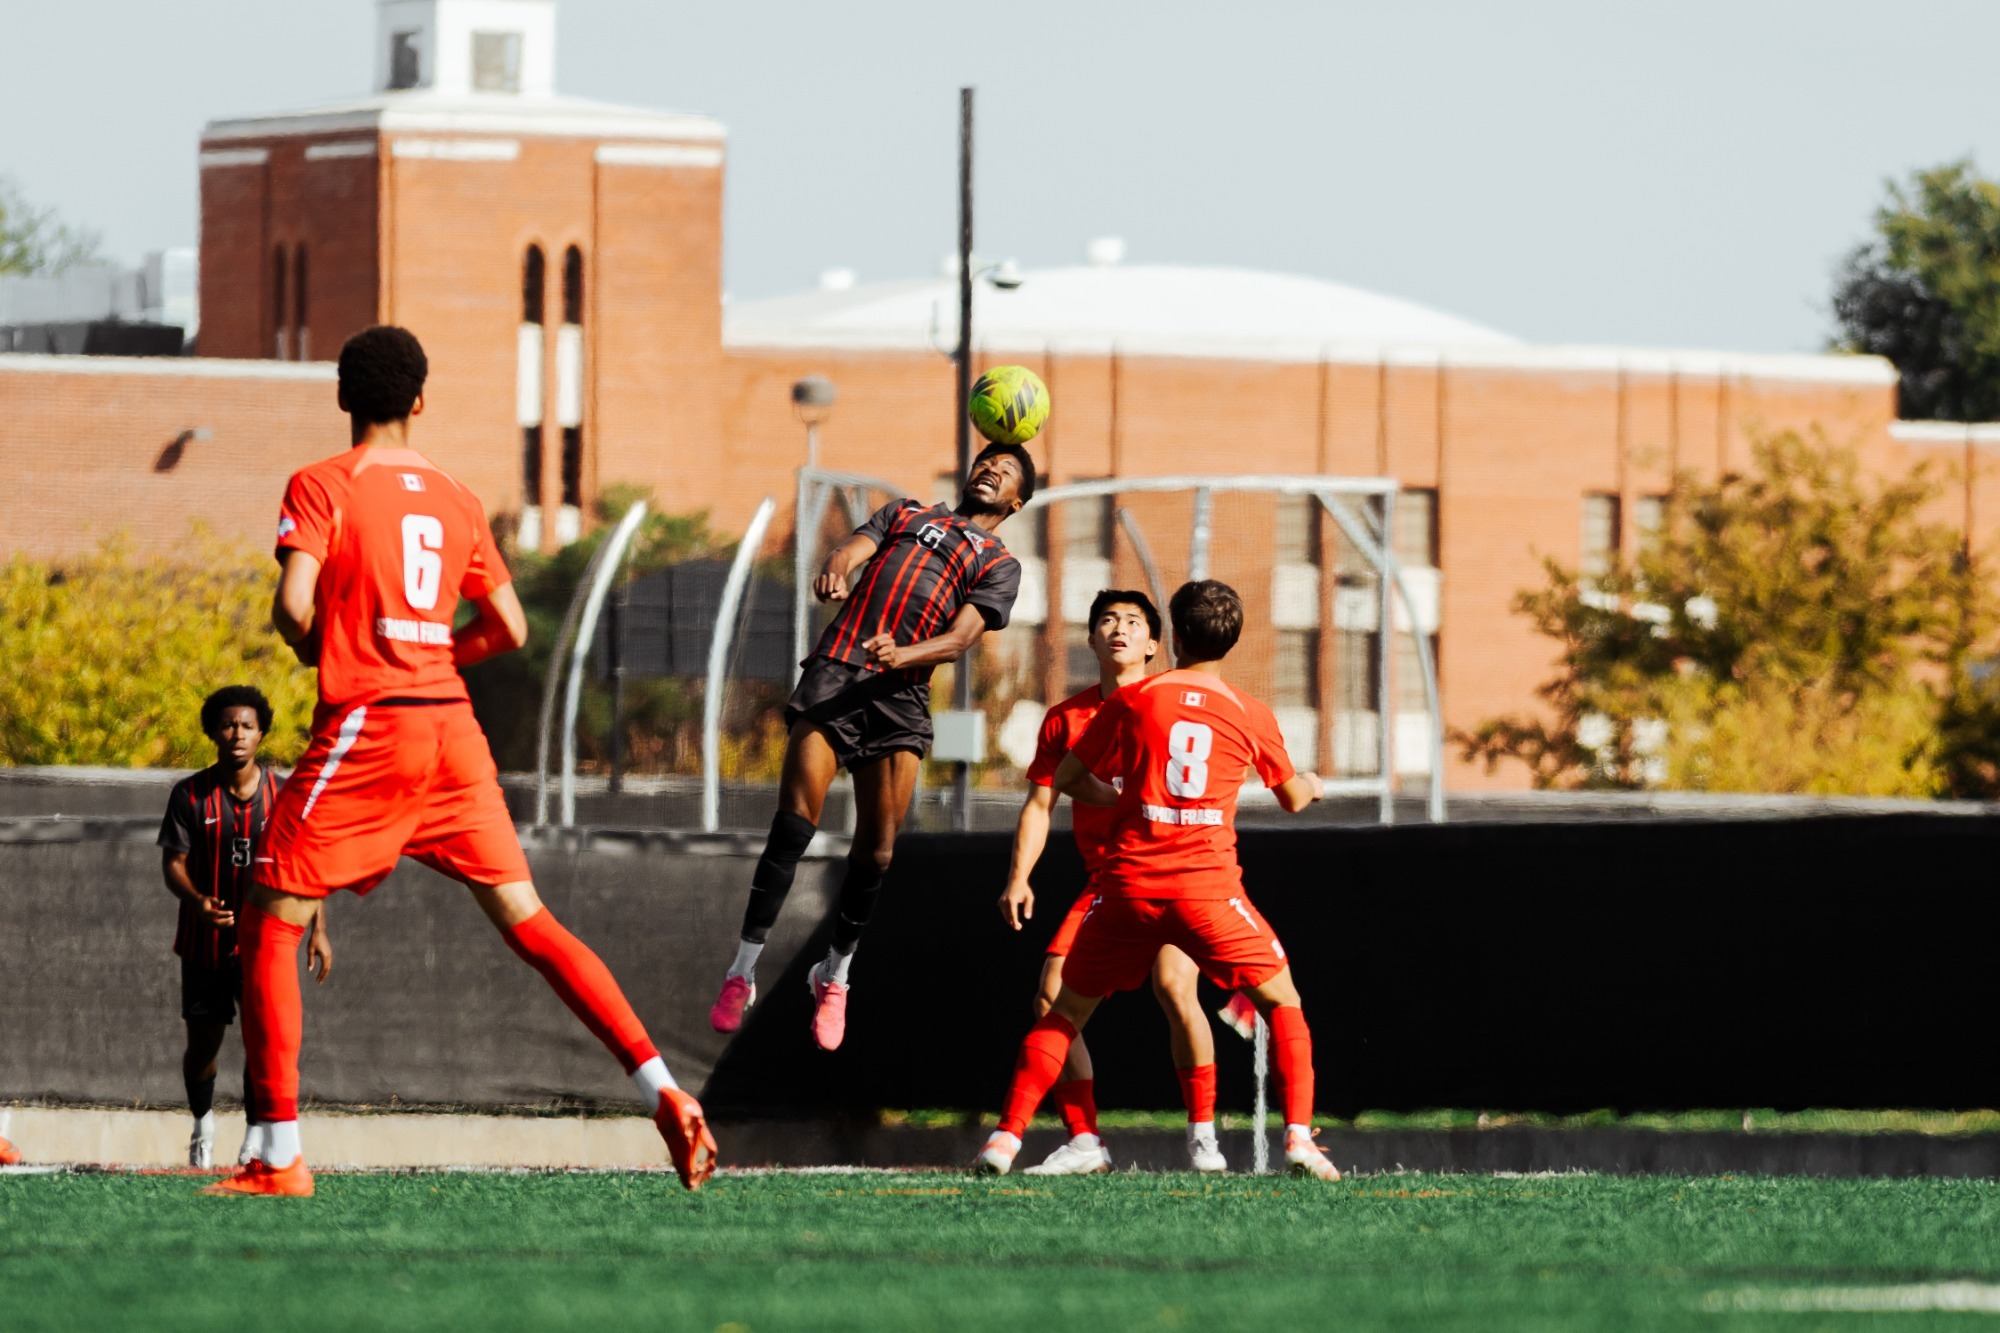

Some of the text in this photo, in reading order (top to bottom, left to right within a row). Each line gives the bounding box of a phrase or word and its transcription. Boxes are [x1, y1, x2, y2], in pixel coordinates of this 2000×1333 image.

[401, 513, 443, 610] 6
[1166, 721, 1212, 799] 8
[232, 838, 250, 867] 5
